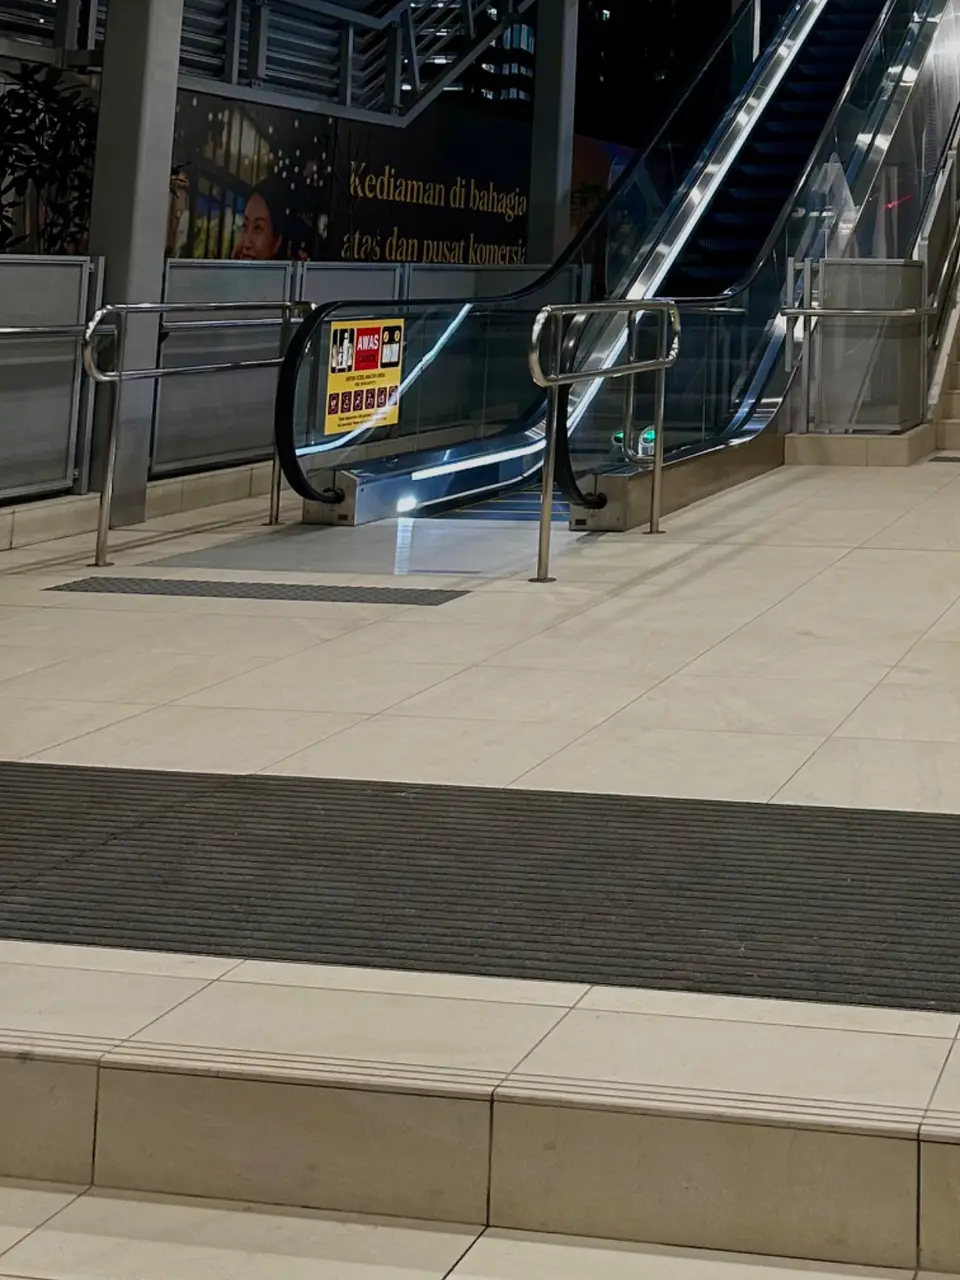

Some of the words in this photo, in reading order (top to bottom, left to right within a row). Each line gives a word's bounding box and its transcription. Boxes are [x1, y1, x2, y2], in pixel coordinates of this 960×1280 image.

[350, 161, 445, 207] Kediaman
[450, 176, 466, 208] di
[469, 178, 527, 222] bahagia
[341, 229, 381, 260] atas
[385, 226, 418, 261] dan
[423, 238, 464, 263] pusat
[357, 334, 379, 350] AWAS
